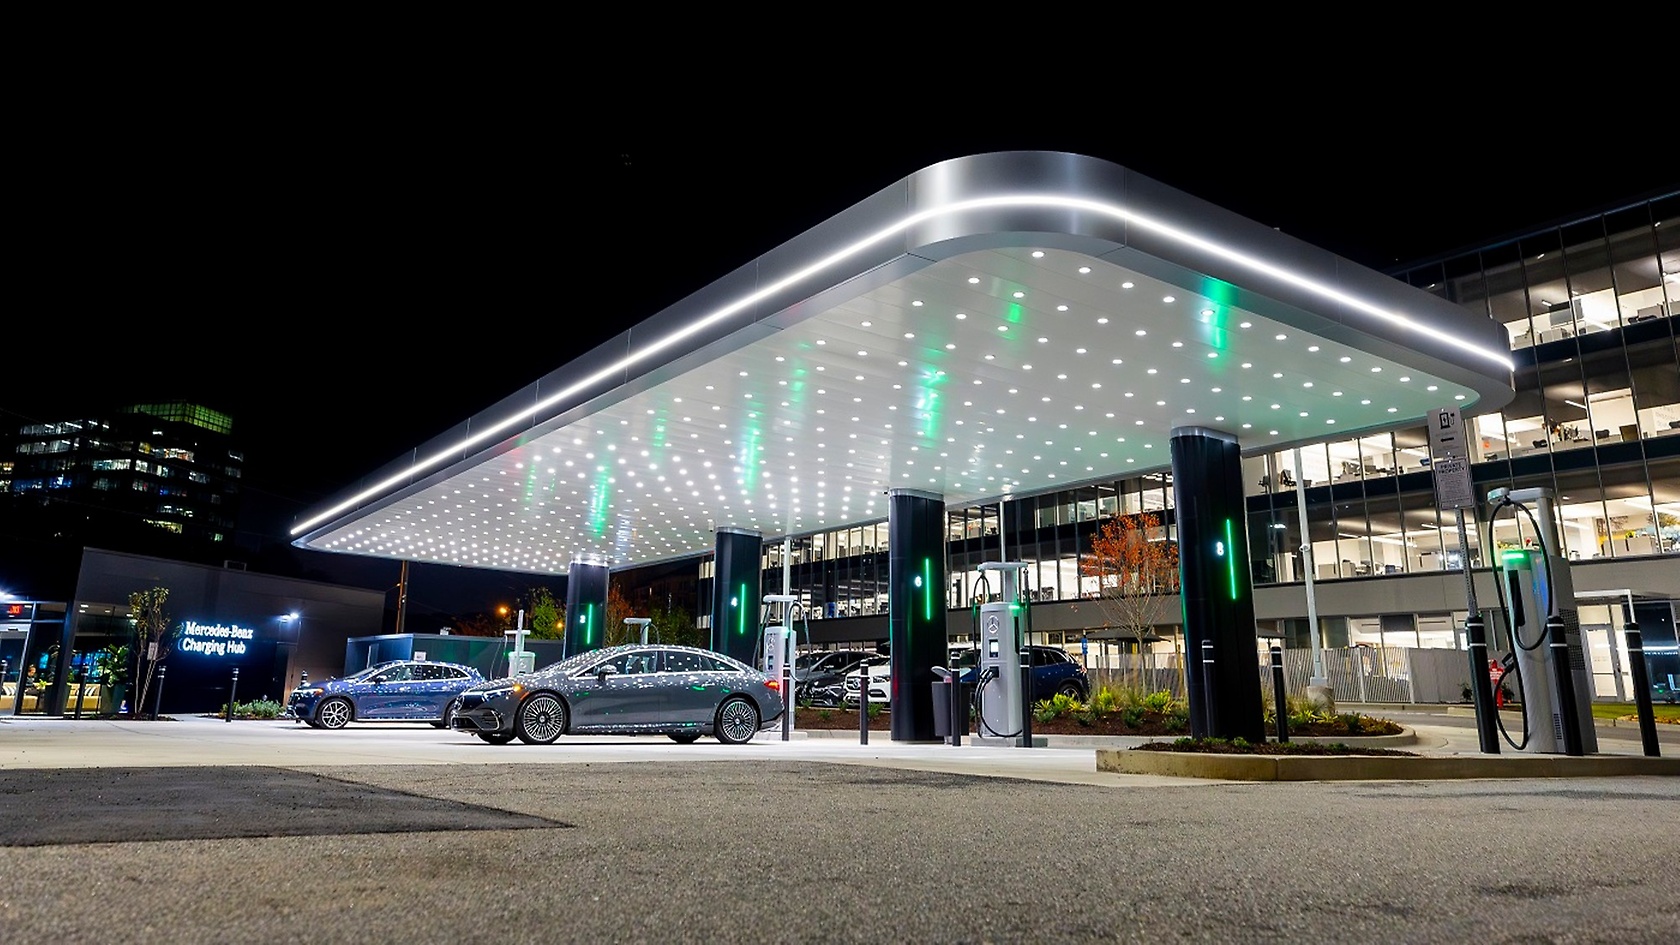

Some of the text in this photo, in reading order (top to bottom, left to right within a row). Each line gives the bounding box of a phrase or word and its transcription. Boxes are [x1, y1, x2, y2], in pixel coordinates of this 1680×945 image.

[1216, 541, 1224, 556] 8
[914, 576, 922, 587] 6
[731, 597, 737, 607] 4
[184, 621, 254, 639] Mercedes-Benz
[182, 637, 246, 656] Charging Hub
